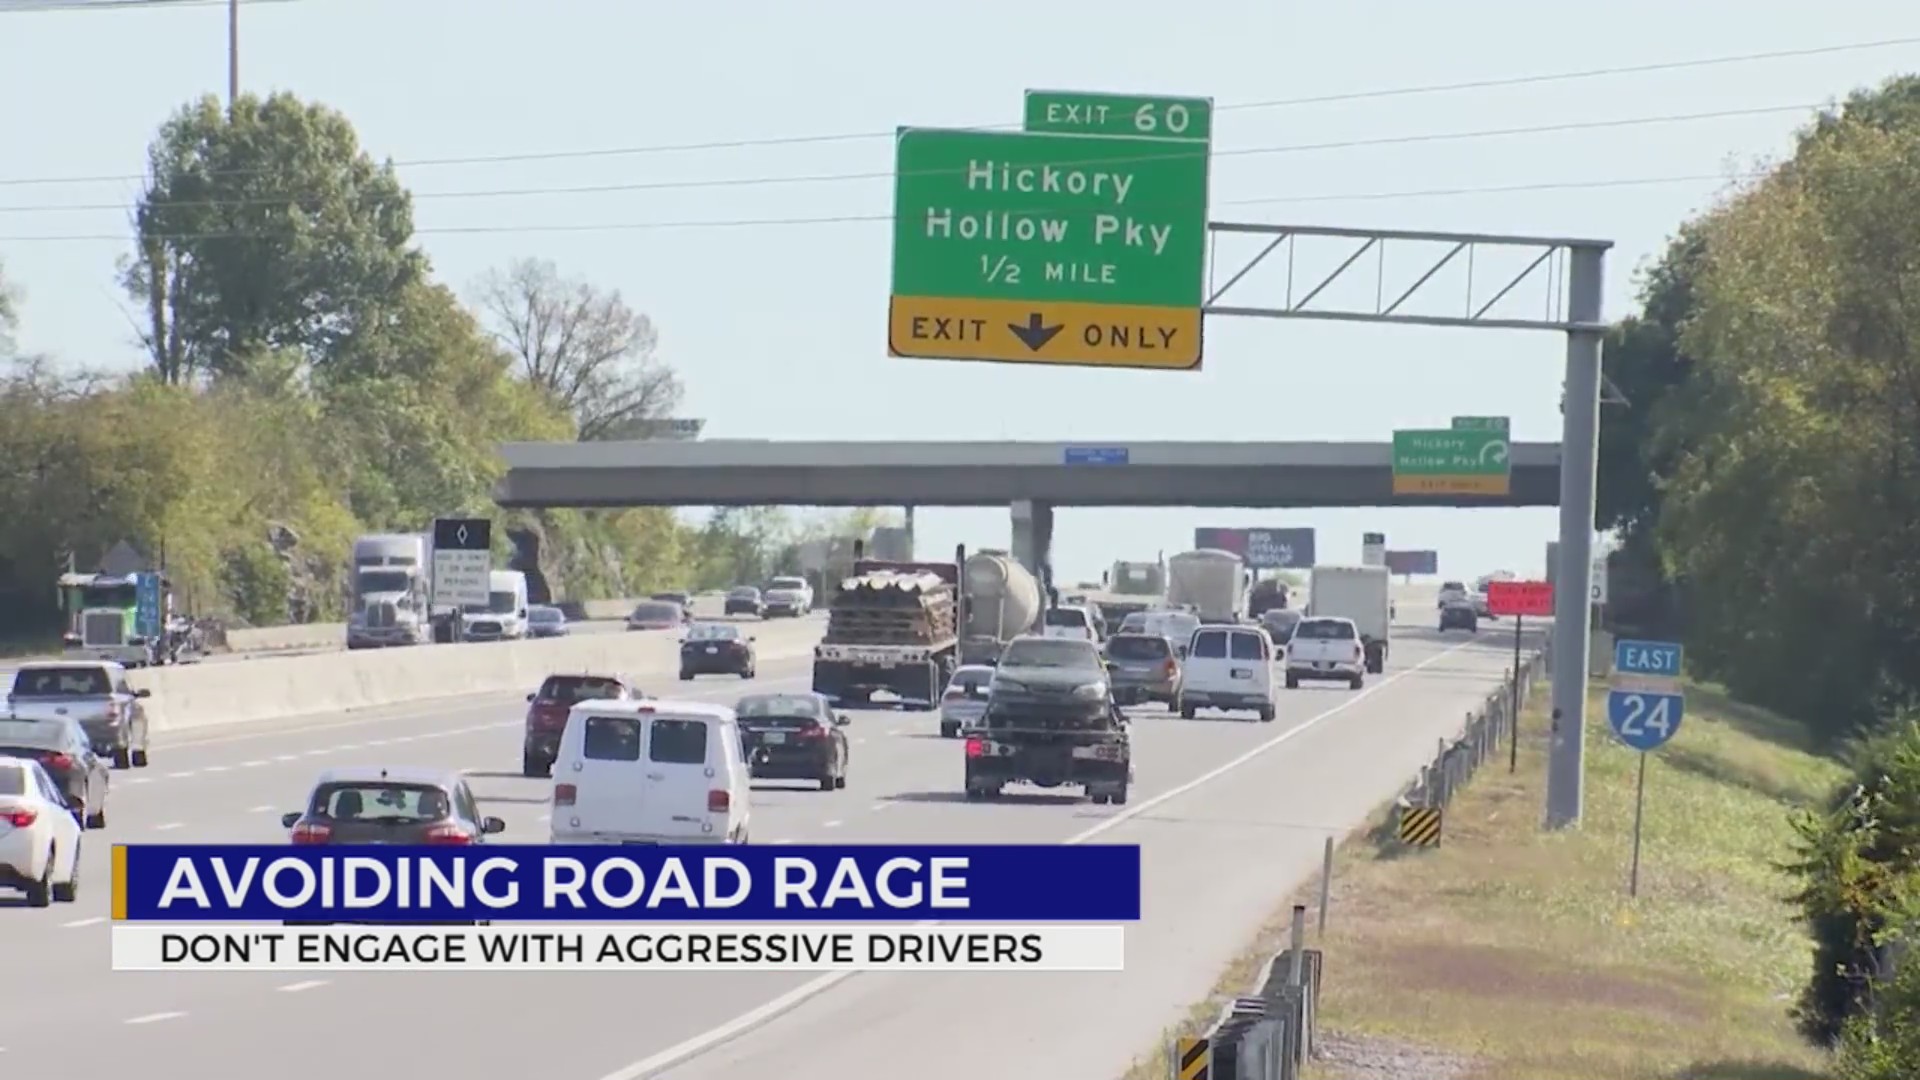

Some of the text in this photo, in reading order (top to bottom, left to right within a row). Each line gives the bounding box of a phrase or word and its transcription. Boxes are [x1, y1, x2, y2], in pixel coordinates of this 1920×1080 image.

[1047, 104, 1189, 133] EXIT 60
[968, 159, 1134, 204] Hickory
[926, 207, 1172, 255] Hollow Pky
[1045, 262, 1116, 284] MILE
[912, 317, 1177, 349] EXIT ONLY
[1625, 648, 1675, 669] EAST
[1621, 694, 1671, 738] 24
